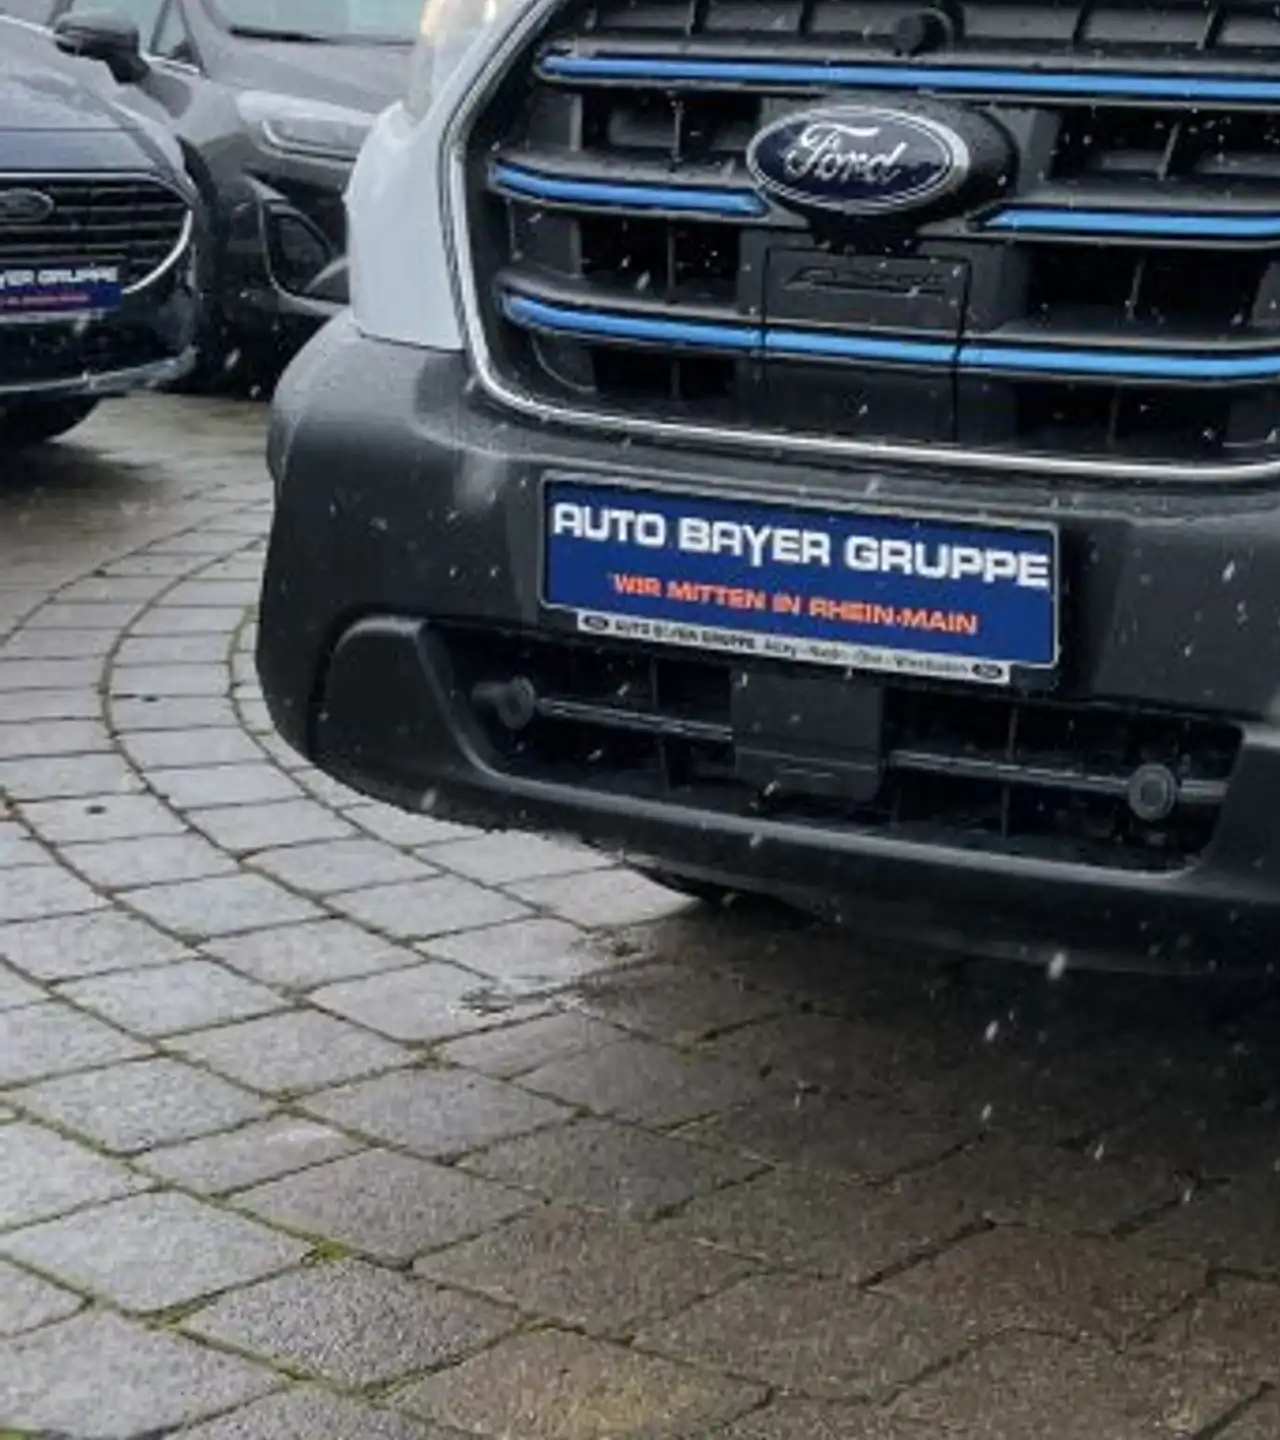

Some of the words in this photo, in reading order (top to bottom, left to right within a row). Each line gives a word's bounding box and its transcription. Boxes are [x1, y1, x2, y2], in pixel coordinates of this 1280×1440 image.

[782, 121, 908, 183] Ford
[553, 501, 667, 549] AUTO
[677, 516, 831, 568] BAYER
[844, 534, 1050, 588] GRUPPE
[613, 572, 660, 597] WIR
[666, 580, 767, 610] MITTEN
[772, 591, 800, 616] IN
[808, 595, 979, 635] RHEIN-MAIN
